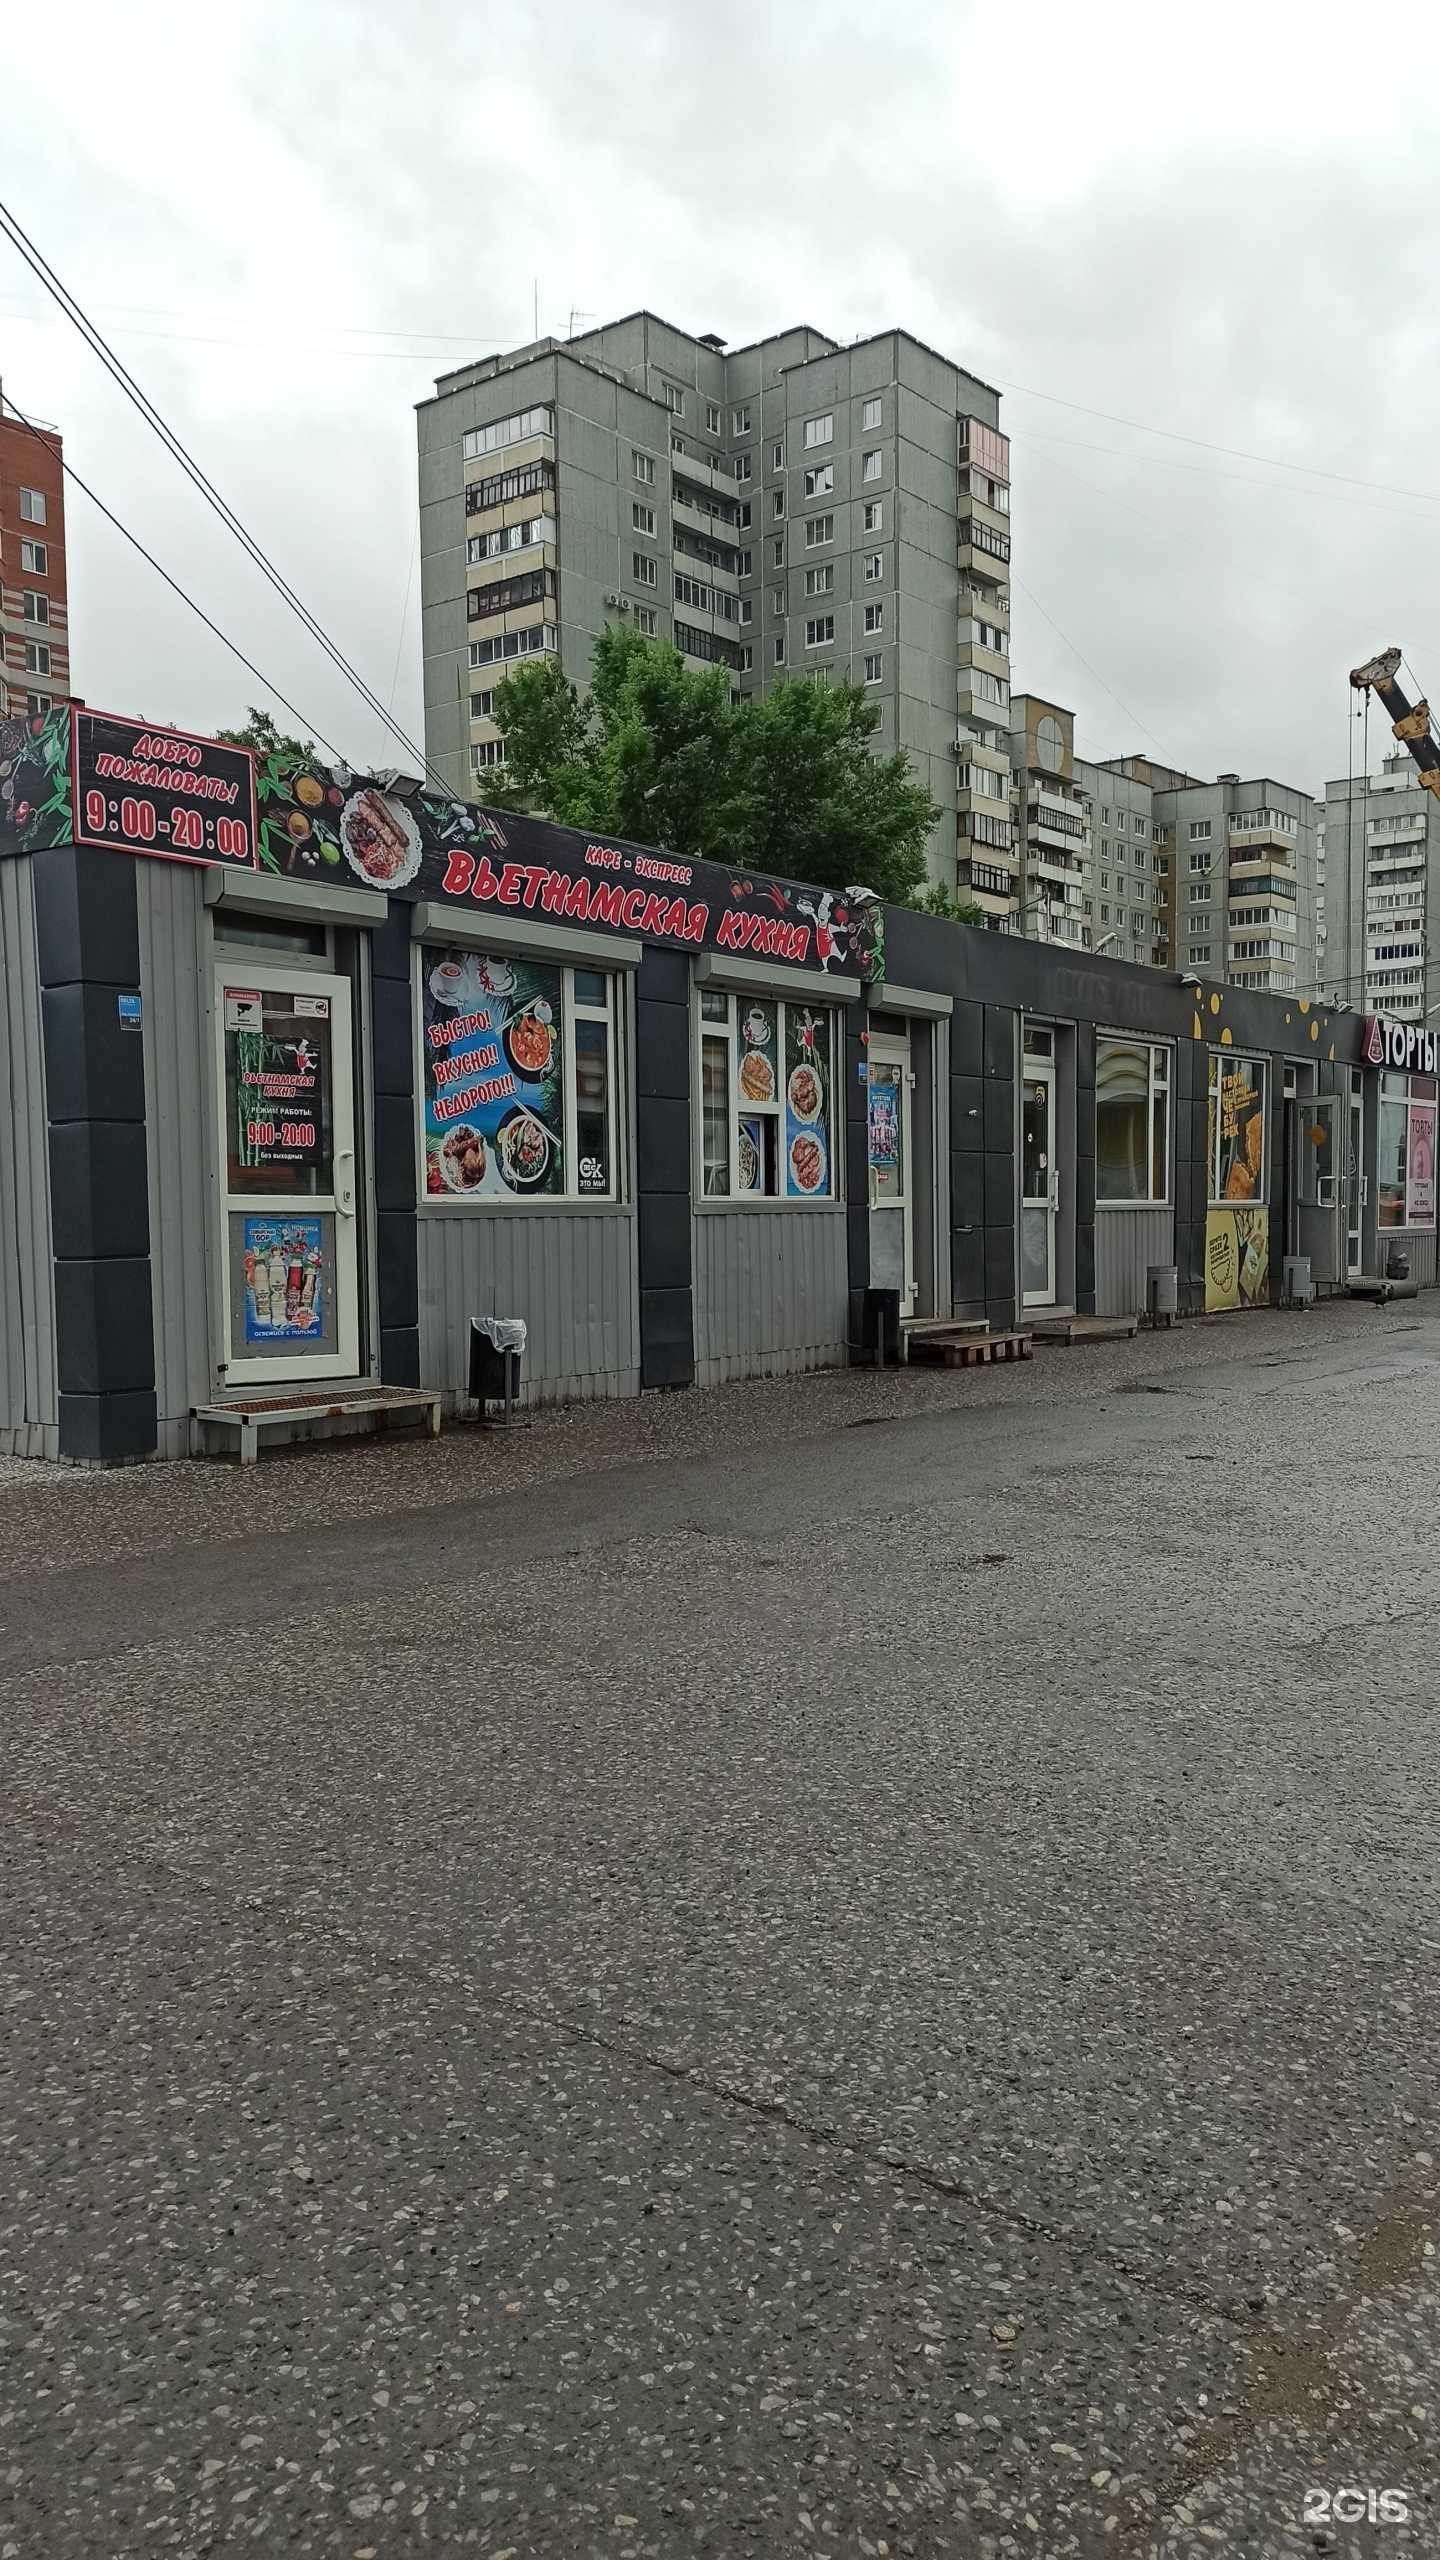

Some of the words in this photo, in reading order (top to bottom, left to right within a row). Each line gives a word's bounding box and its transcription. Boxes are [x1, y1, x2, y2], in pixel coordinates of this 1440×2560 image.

[133, 734, 202, 767] ДОБРО
[96, 753, 239, 804] ПОЖАЛОВАТЬ!
[585, 845, 621, 870] КАФЕ
[635, 856, 693, 886] ЭКСПРЕСС
[442, 850, 709, 942] ВЬЕТНАМСКАЯ
[716, 909, 810, 961] КУХНЯ
[428, 1009, 492, 1047] БЫСТРО!
[1383, 1020, 1437, 1073] ТОРТЫ
[243, 1072, 315, 1087] ВЬЕТНАМСКАЯ
[432, 1043, 499, 1084] ВКУСНО!!
[263, 1085, 296, 1097] КУХНЯ
[433, 1073, 517, 1121] НЕДОРОГО!!!
[280, 1107, 312, 1116] РАБОТЫ:
[1411, 1119, 1432, 1136] ТОРТЫ
